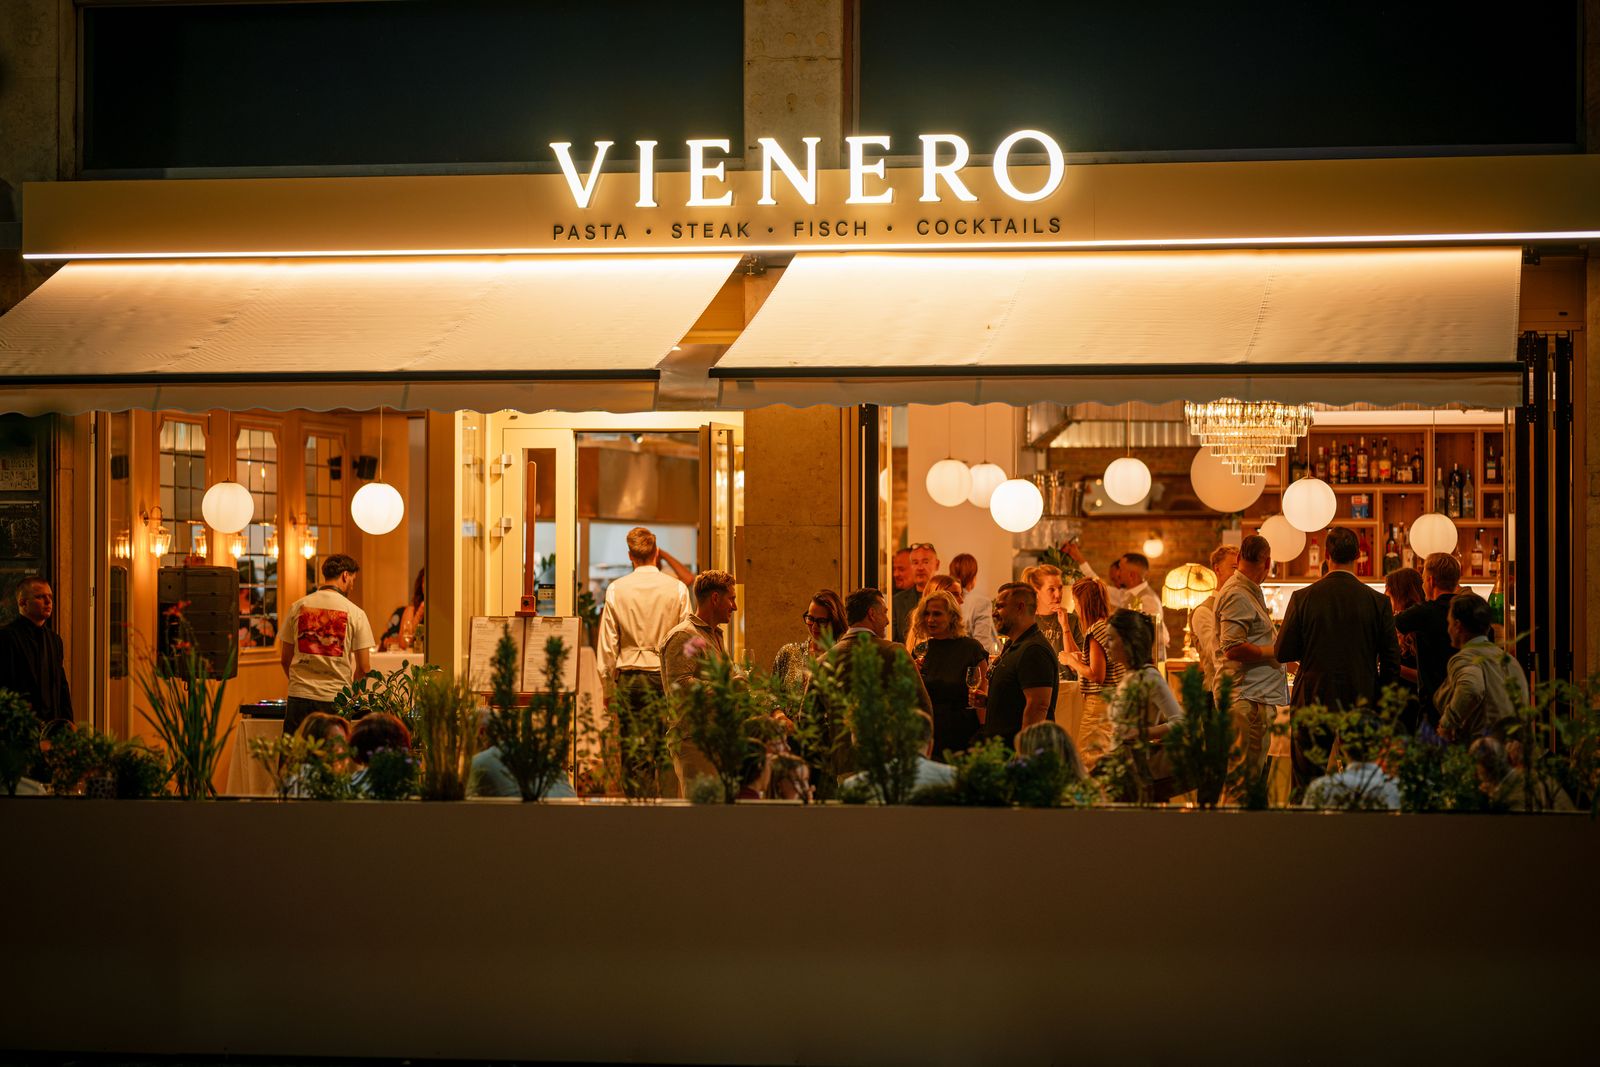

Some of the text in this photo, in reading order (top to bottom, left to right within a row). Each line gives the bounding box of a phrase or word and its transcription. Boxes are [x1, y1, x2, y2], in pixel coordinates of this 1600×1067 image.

[549, 129, 1066, 209] VIENERO
[553, 216, 1062, 241] PASTA STEAK FISCH COCKTAILS
